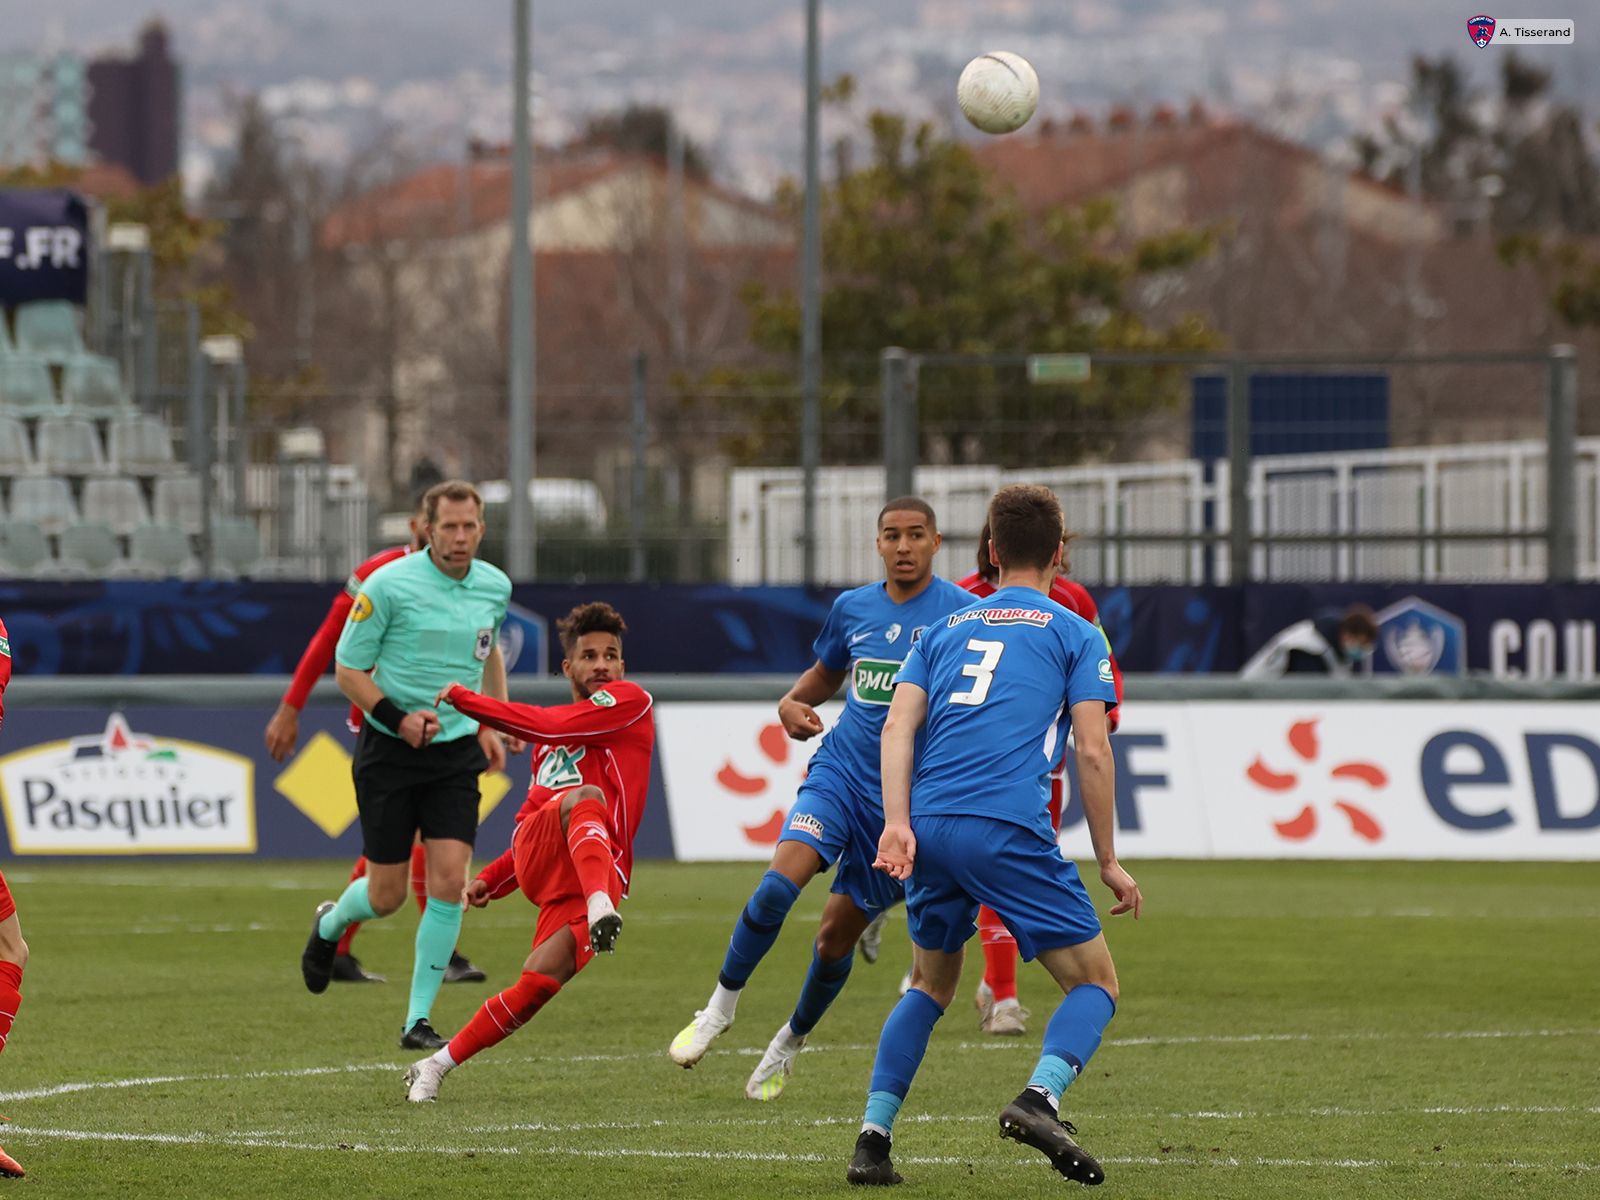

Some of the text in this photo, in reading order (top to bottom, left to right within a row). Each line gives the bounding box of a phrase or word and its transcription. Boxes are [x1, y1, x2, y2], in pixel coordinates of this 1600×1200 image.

[857, 669, 896, 692] PMU
[949, 639, 1004, 705] 3
[22, 779, 234, 840] Pasquier
